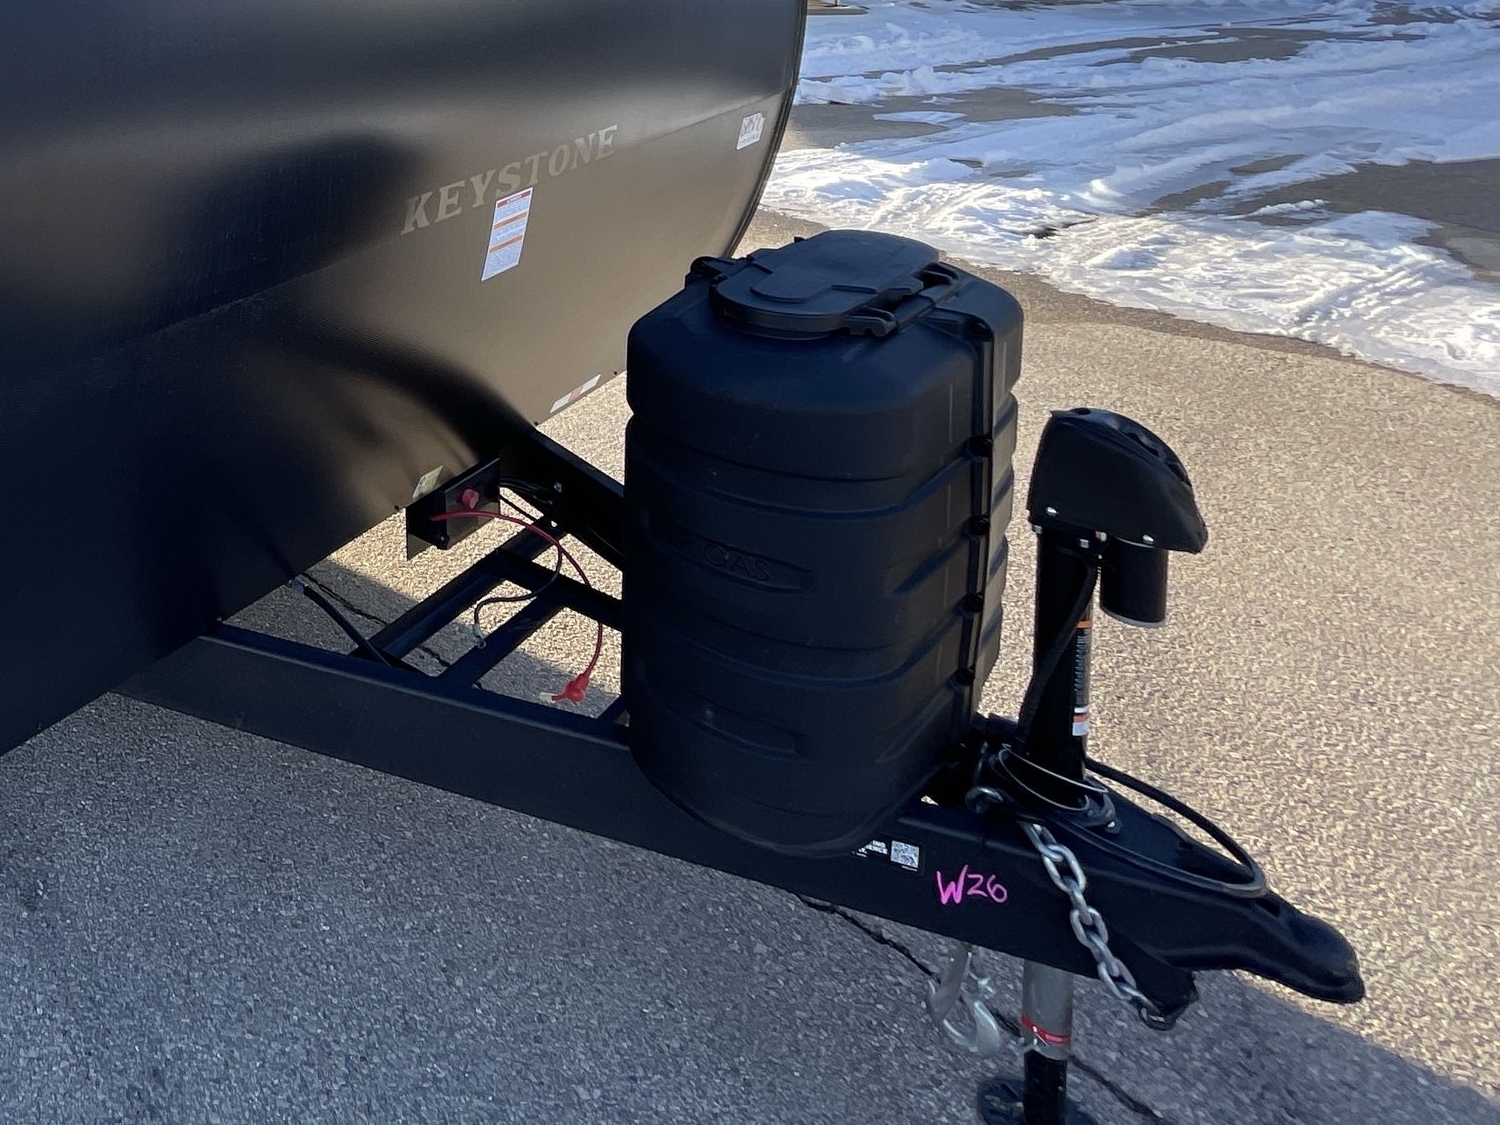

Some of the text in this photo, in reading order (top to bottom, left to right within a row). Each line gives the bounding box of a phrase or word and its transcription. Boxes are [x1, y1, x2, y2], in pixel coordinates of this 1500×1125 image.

[400, 124, 618, 236] KEYSTONE
[703, 544, 773, 581] GAS
[935, 864, 1008, 905] W26
